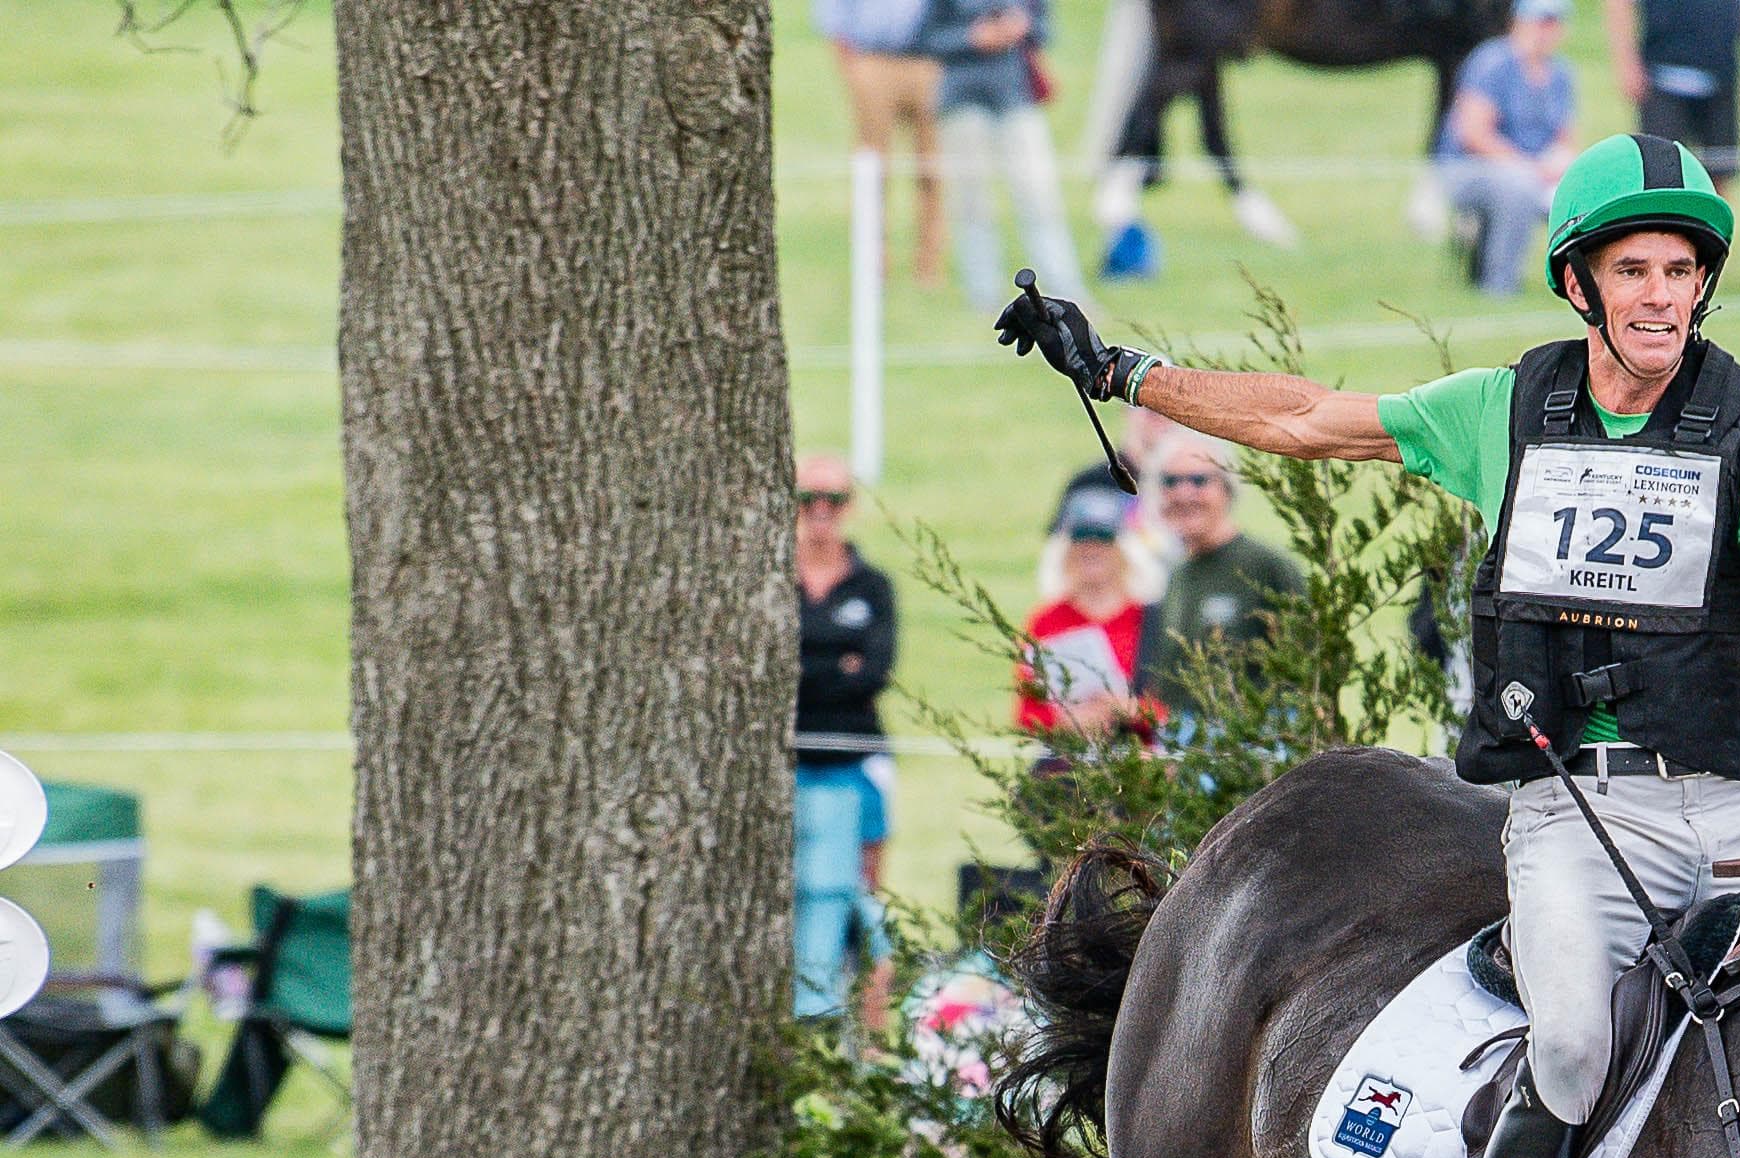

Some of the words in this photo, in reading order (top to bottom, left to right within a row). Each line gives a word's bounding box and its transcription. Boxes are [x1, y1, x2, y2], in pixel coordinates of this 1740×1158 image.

[1635, 465, 1701, 480] COSEQUIN
[1634, 479, 1699, 495] LEXINGTON
[1553, 506, 1674, 569] 125
[1570, 569, 1637, 592] KREITL
[1559, 611, 1638, 630] AUBRION
[1346, 1119, 1385, 1144] WORLD
